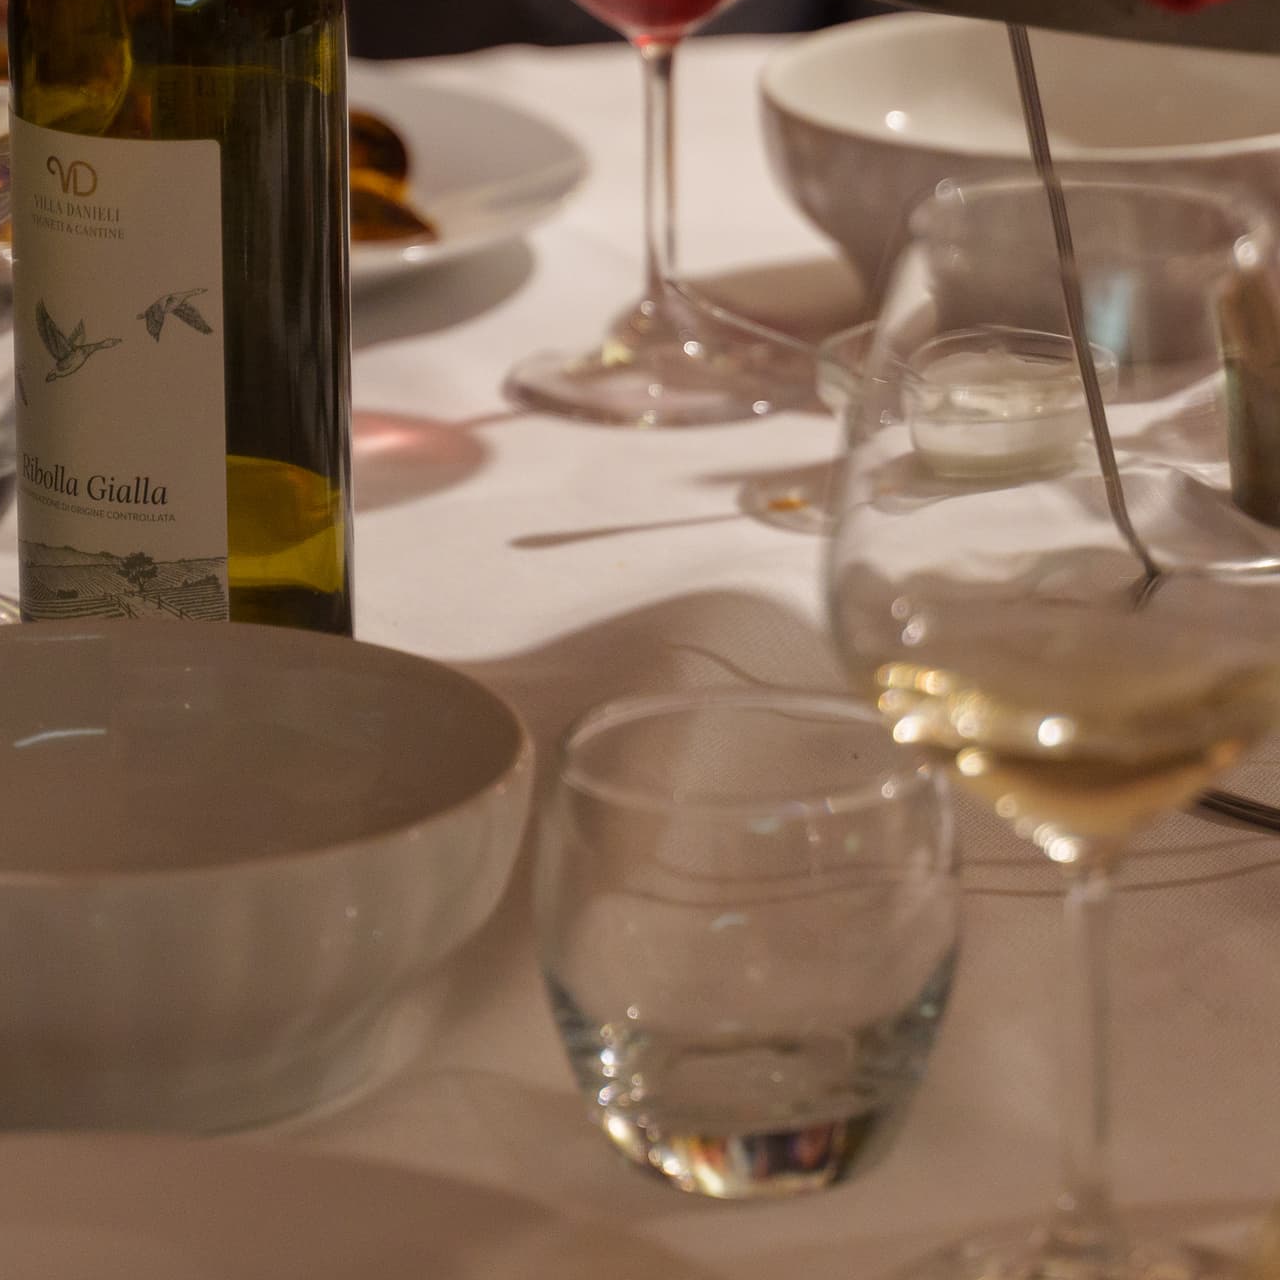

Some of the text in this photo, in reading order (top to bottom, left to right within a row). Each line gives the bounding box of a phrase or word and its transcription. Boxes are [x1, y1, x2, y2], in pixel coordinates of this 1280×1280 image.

[32, 193, 120, 223] VILLA DANIELI
[75, 224, 125, 240] CANTINE
[23, 453, 169, 506] Ribolla Gialla
[70, 505, 105, 519] ORIGINE
[106, 510, 176, 522] CONTROLLATA
